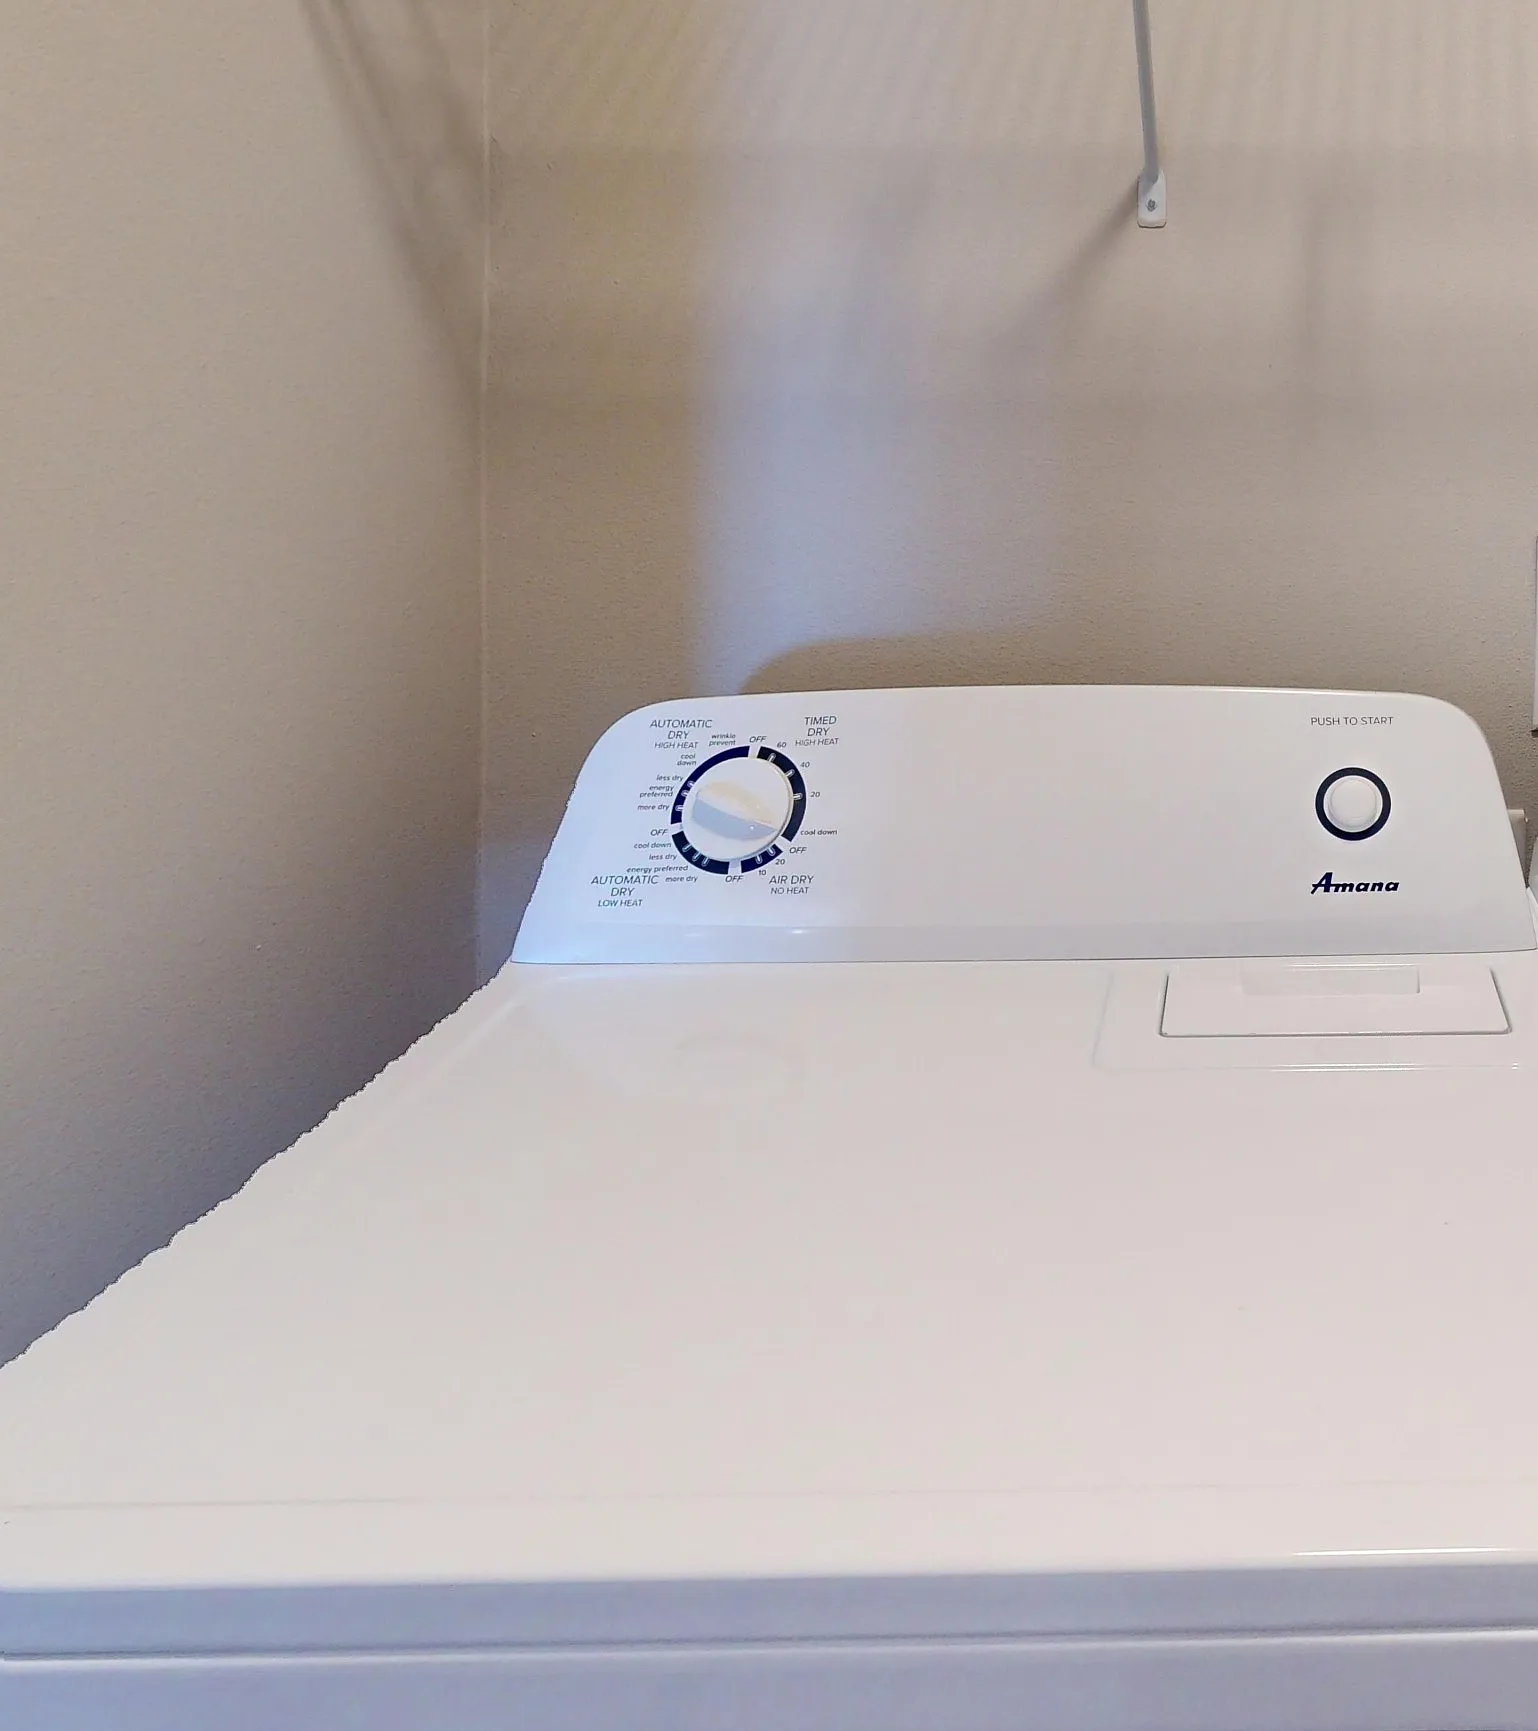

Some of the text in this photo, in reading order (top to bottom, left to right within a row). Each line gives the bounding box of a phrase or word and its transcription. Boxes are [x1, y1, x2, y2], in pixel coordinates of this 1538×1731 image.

[650, 720, 713, 729] AUTOMATIC
[804, 716, 837, 725] TIMED
[1310, 716, 1394, 726] PUSH TO START
[668, 730, 690, 739] DRY
[808, 728, 830, 736] DRY
[817, 738, 839, 746] HEAT
[672, 774, 684, 782] dry
[654, 865, 689, 873] preferred
[590, 875, 660, 885] AUTOMATIC
[725, 875, 744, 883] OFF
[769, 875, 814, 884] AIR DRY
[1310, 872, 1400, 894] Amana
[610, 887, 635, 897] DRY
